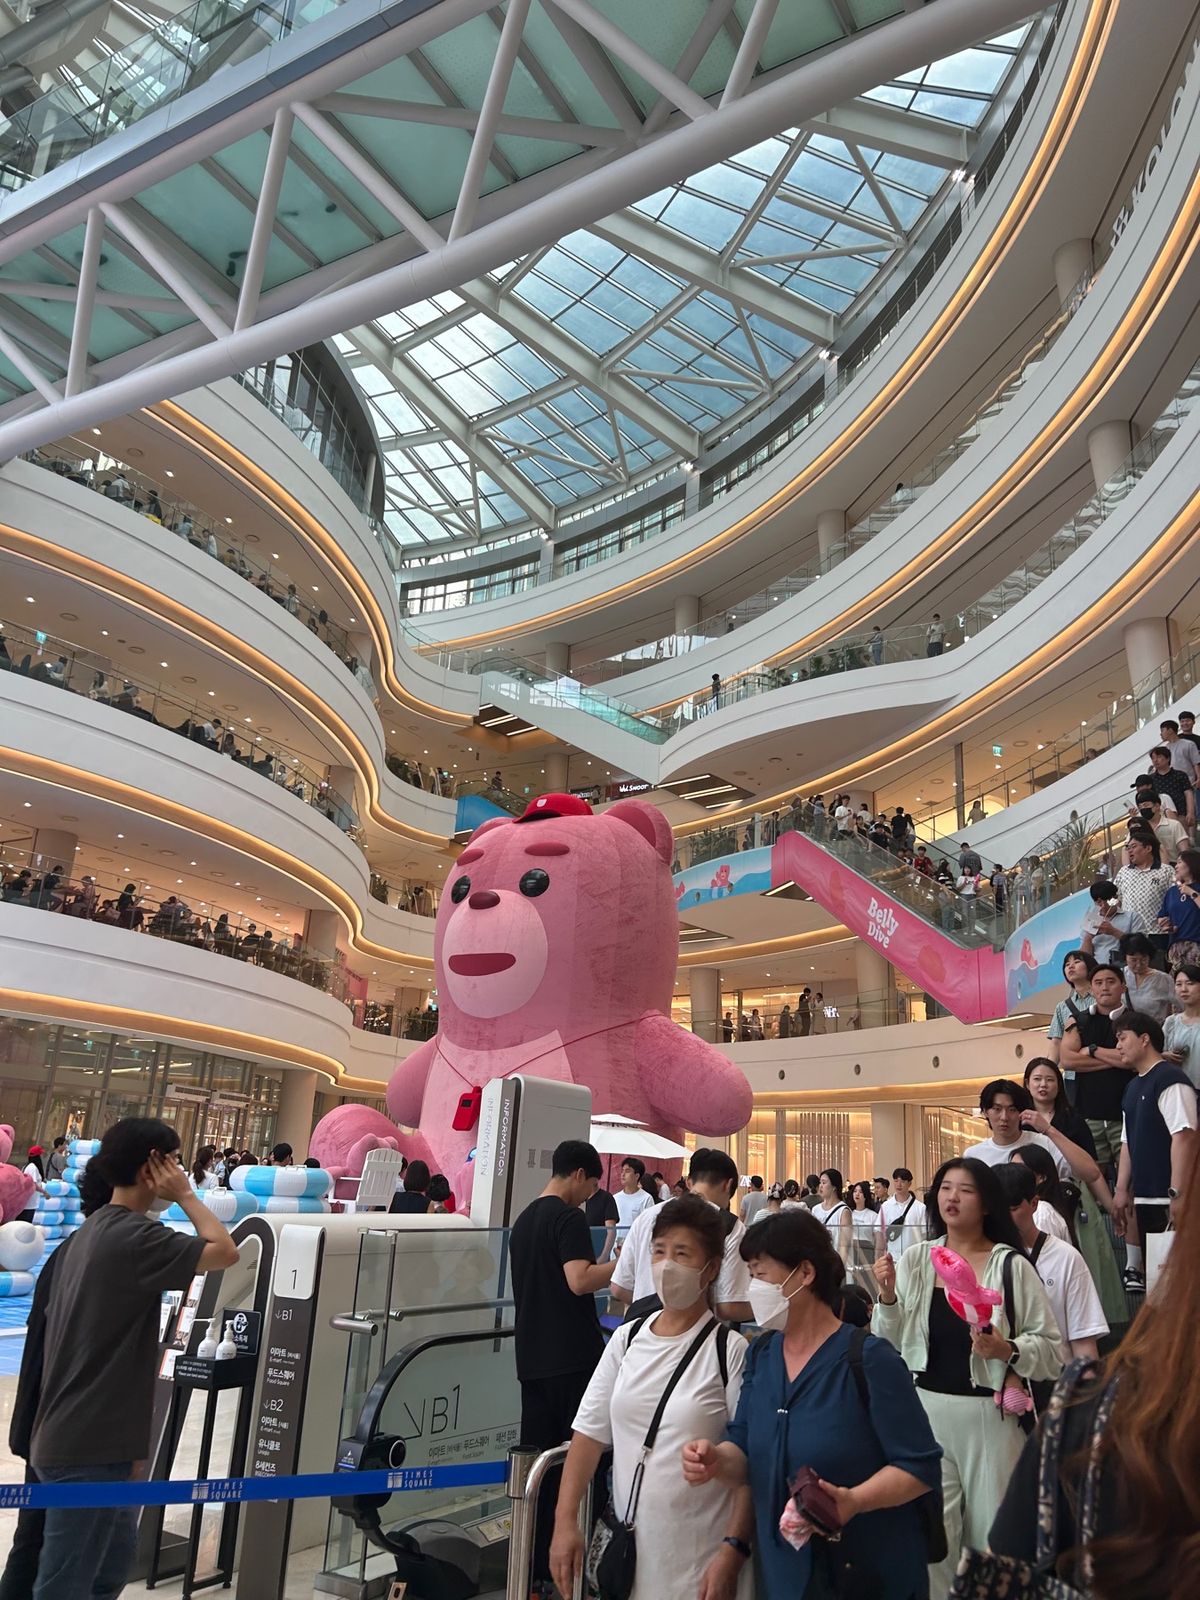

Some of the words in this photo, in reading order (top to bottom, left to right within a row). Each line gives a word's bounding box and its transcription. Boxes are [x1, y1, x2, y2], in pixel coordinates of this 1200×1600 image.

[867, 896, 899, 936] Belly
[867, 921, 890, 949] Dive
[498, 1098, 510, 1176] INFORMATION
[292, 1269, 297, 1290] 1
[281, 1309, 293, 1321] B1
[270, 1347, 287, 1357] 이마트
[267, 1367, 295, 1380] 푸드스퀘어
[270, 1399, 284, 1412] B2
[430, 1384, 460, 1435] B1
[404, 1470, 433, 1479] TIMES
[211, 1481, 243, 1490] TIMES
[404, 1478, 432, 1488] SQUARE
[0, 1496, 31, 1506] QUARE
[211, 1490, 242, 1500] SQUARE
